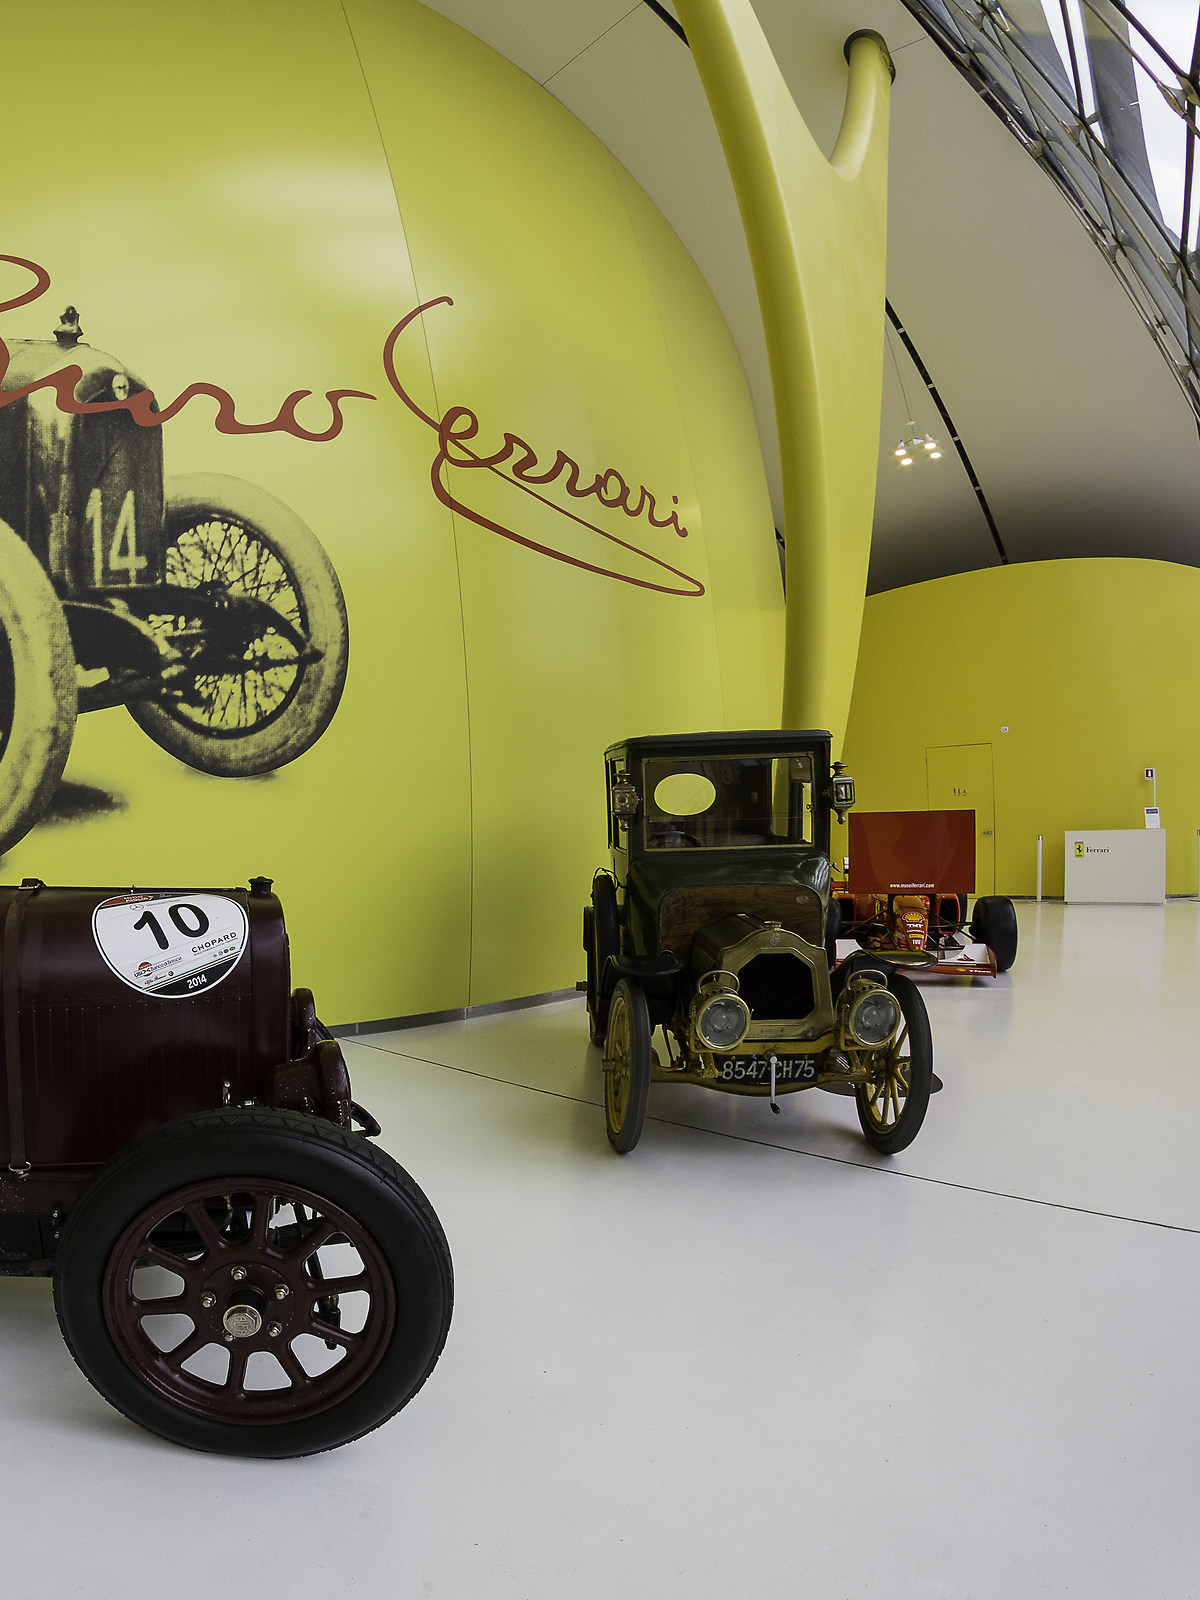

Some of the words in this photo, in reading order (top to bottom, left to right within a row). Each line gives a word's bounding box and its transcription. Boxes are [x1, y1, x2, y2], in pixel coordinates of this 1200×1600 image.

[384, 297, 705, 596] Ferrari
[86, 488, 147, 588] 14
[133, 903, 210, 950] 10
[191, 932, 237, 953] CHOPARD
[186, 974, 208, 989] 2014
